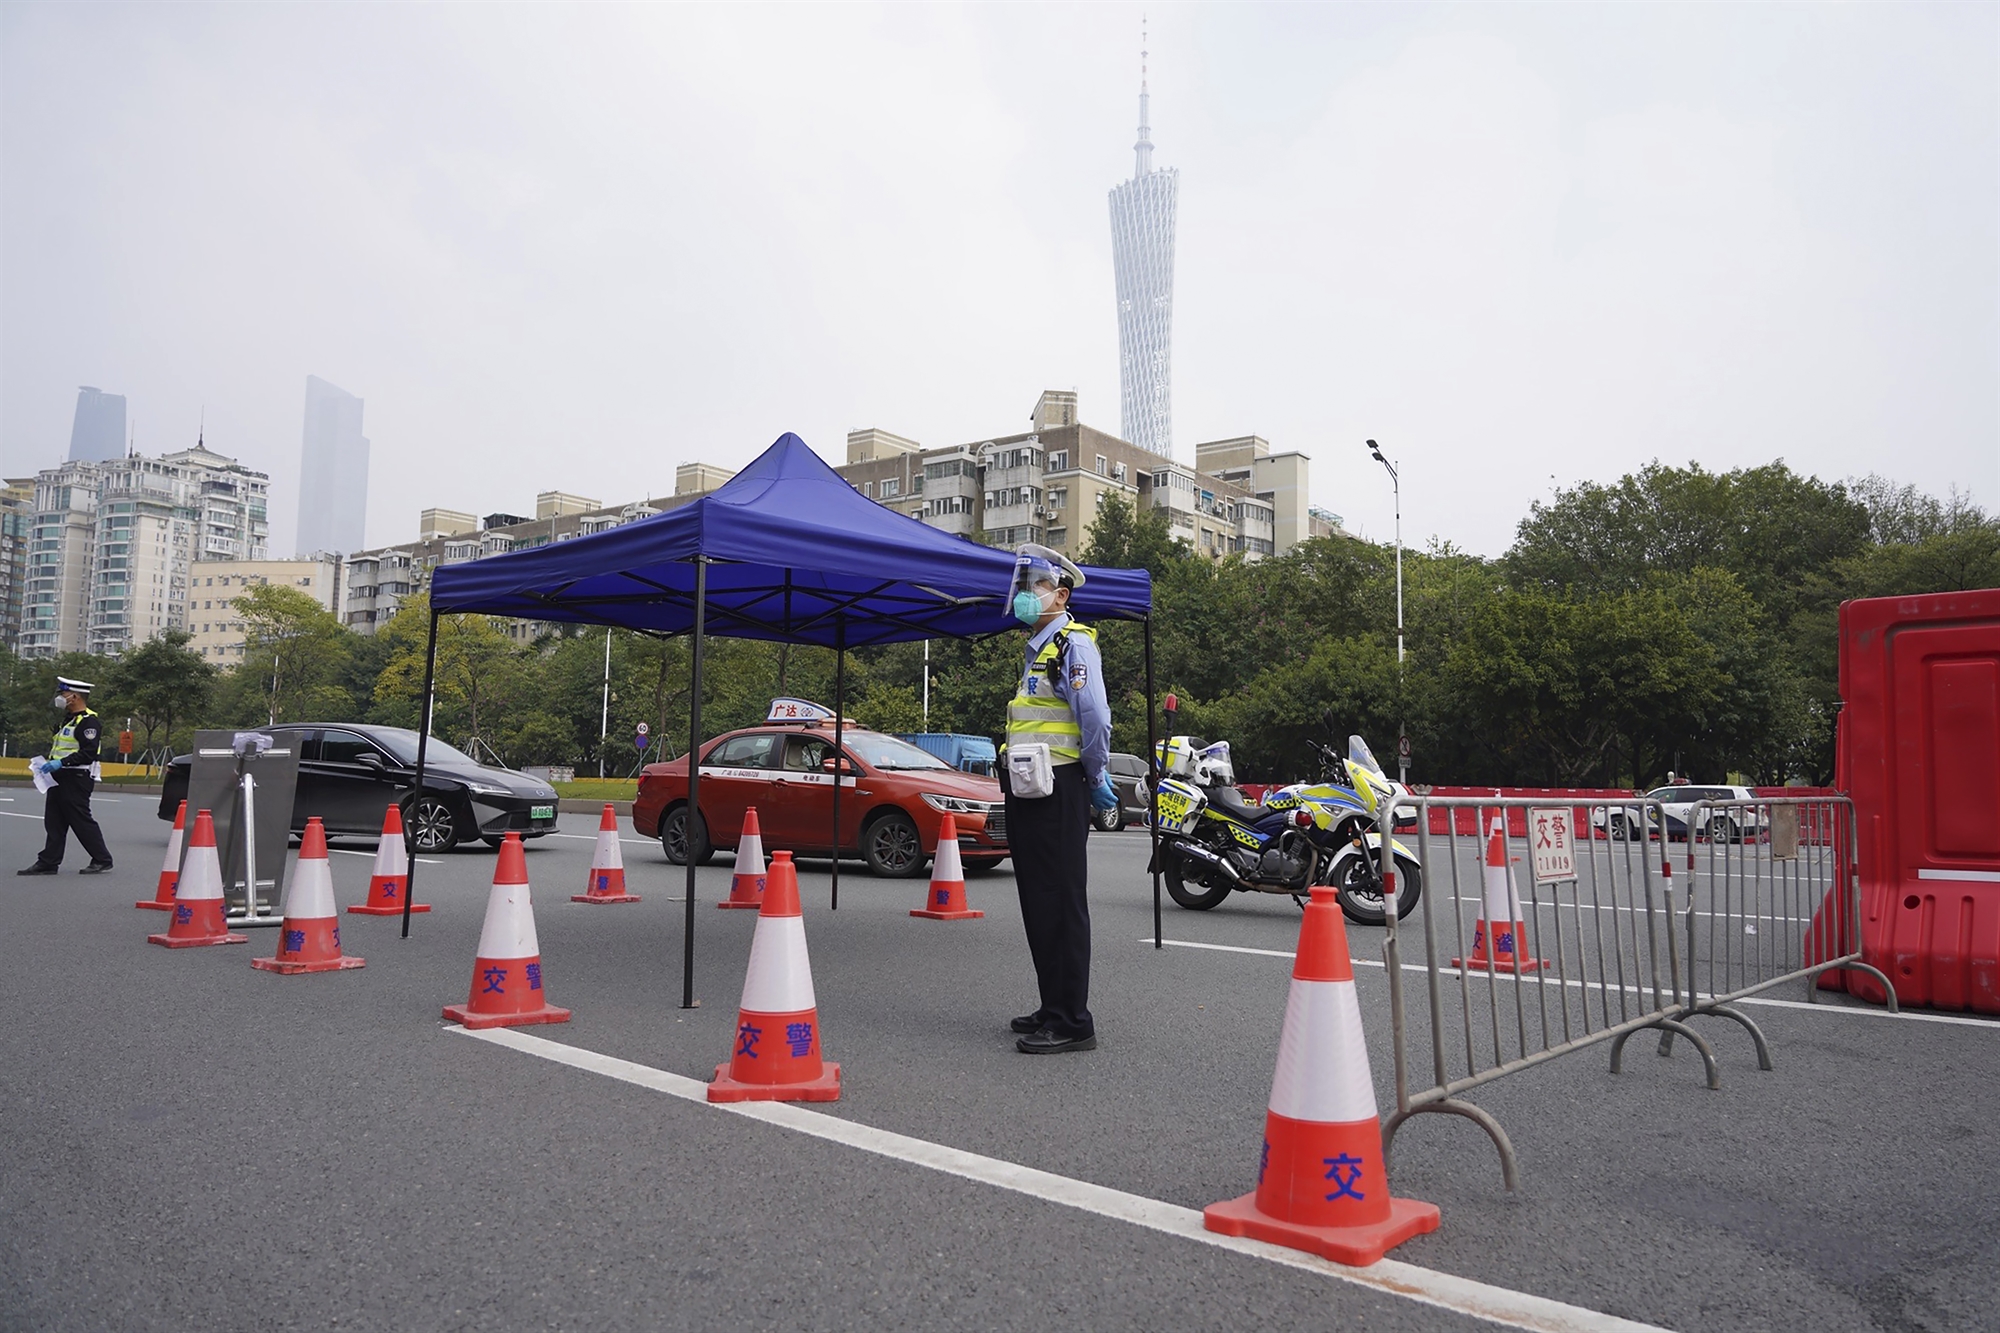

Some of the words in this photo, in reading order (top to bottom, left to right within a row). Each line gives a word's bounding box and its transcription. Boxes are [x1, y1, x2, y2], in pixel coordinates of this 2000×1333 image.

[773, 704, 797, 717] 广达
[1162, 799, 1178, 810] POLICE
[1537, 814, 1566, 849] 交警
[383, 881, 397, 897] 交
[1323, 1152, 1365, 1201] 交
